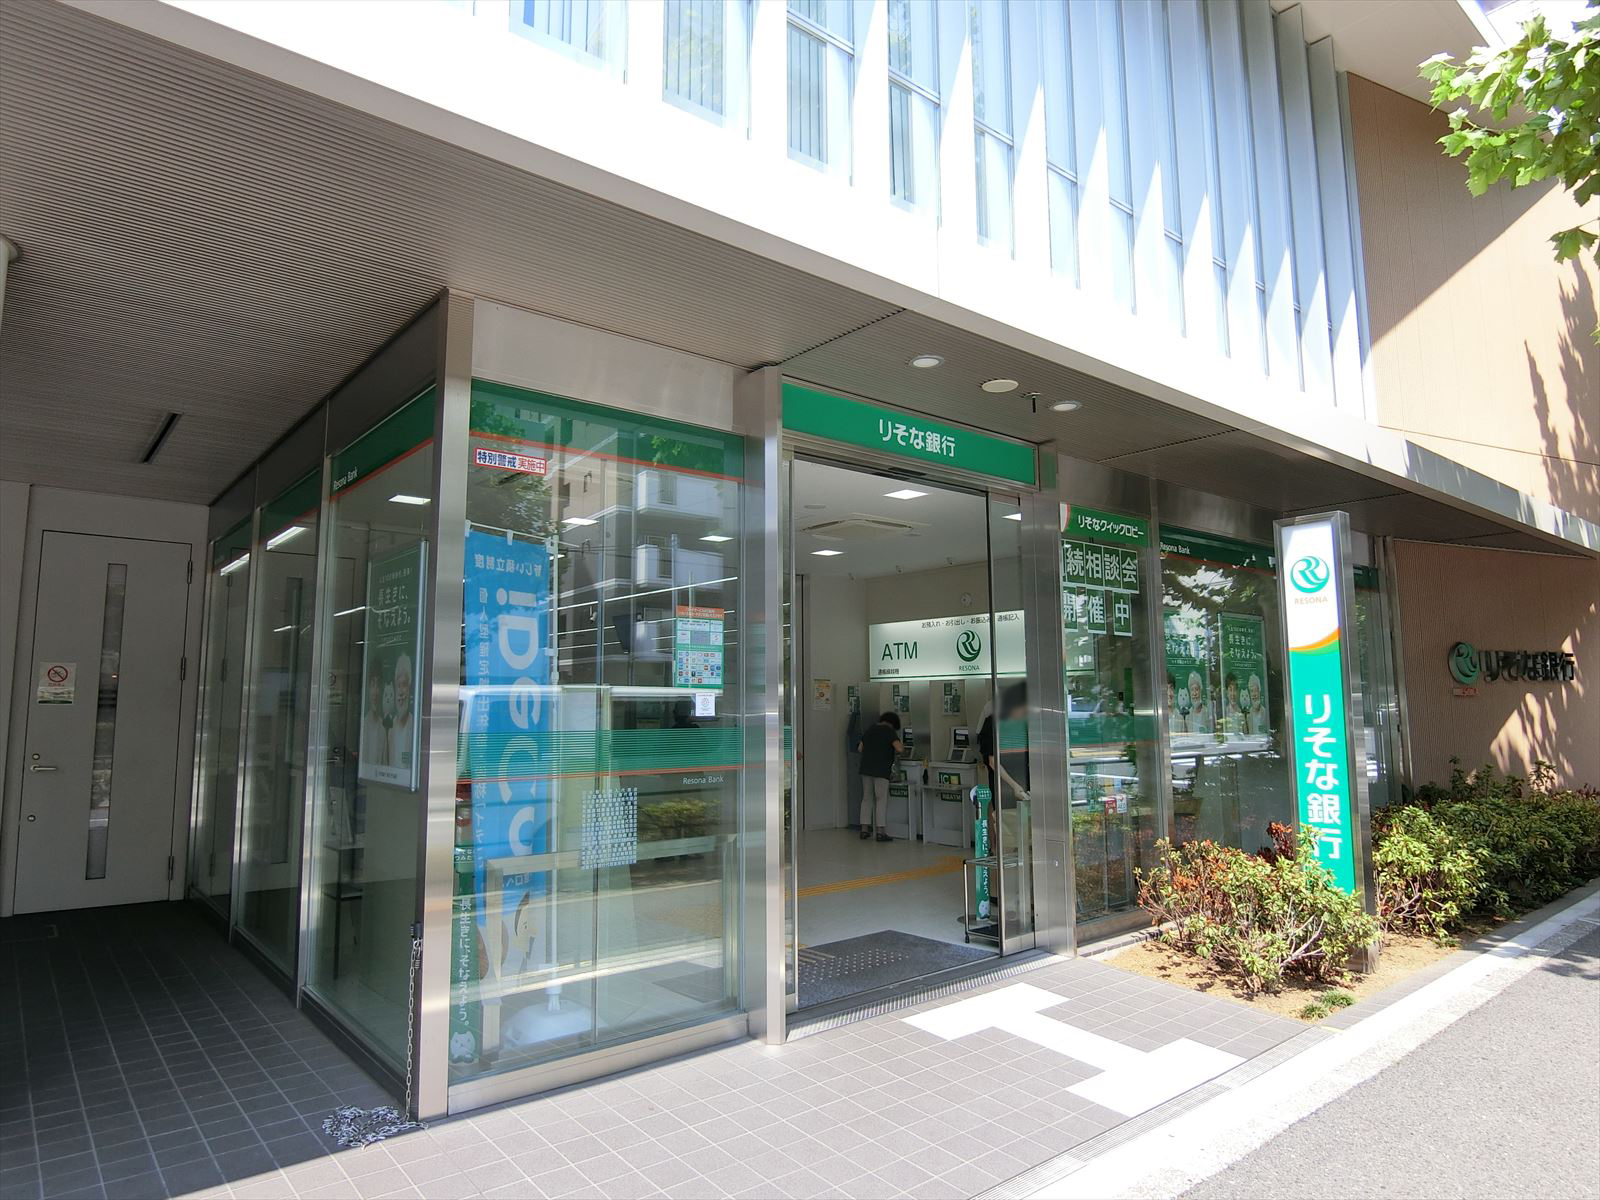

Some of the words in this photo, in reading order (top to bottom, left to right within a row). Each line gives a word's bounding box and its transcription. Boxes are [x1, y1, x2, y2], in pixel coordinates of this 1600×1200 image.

[879, 418, 956, 457] りそな銀行
[1077, 514, 1145, 538] りそなクイックロビー
[1061, 546, 1137, 584] 続相談会
[1294, 596, 1328, 605] RESONA
[881, 641, 918, 661] ATM
[682, 777, 706, 785] Resona
[708, 775, 724, 783] Bank
[1303, 693, 1343, 860] りそな銀行
